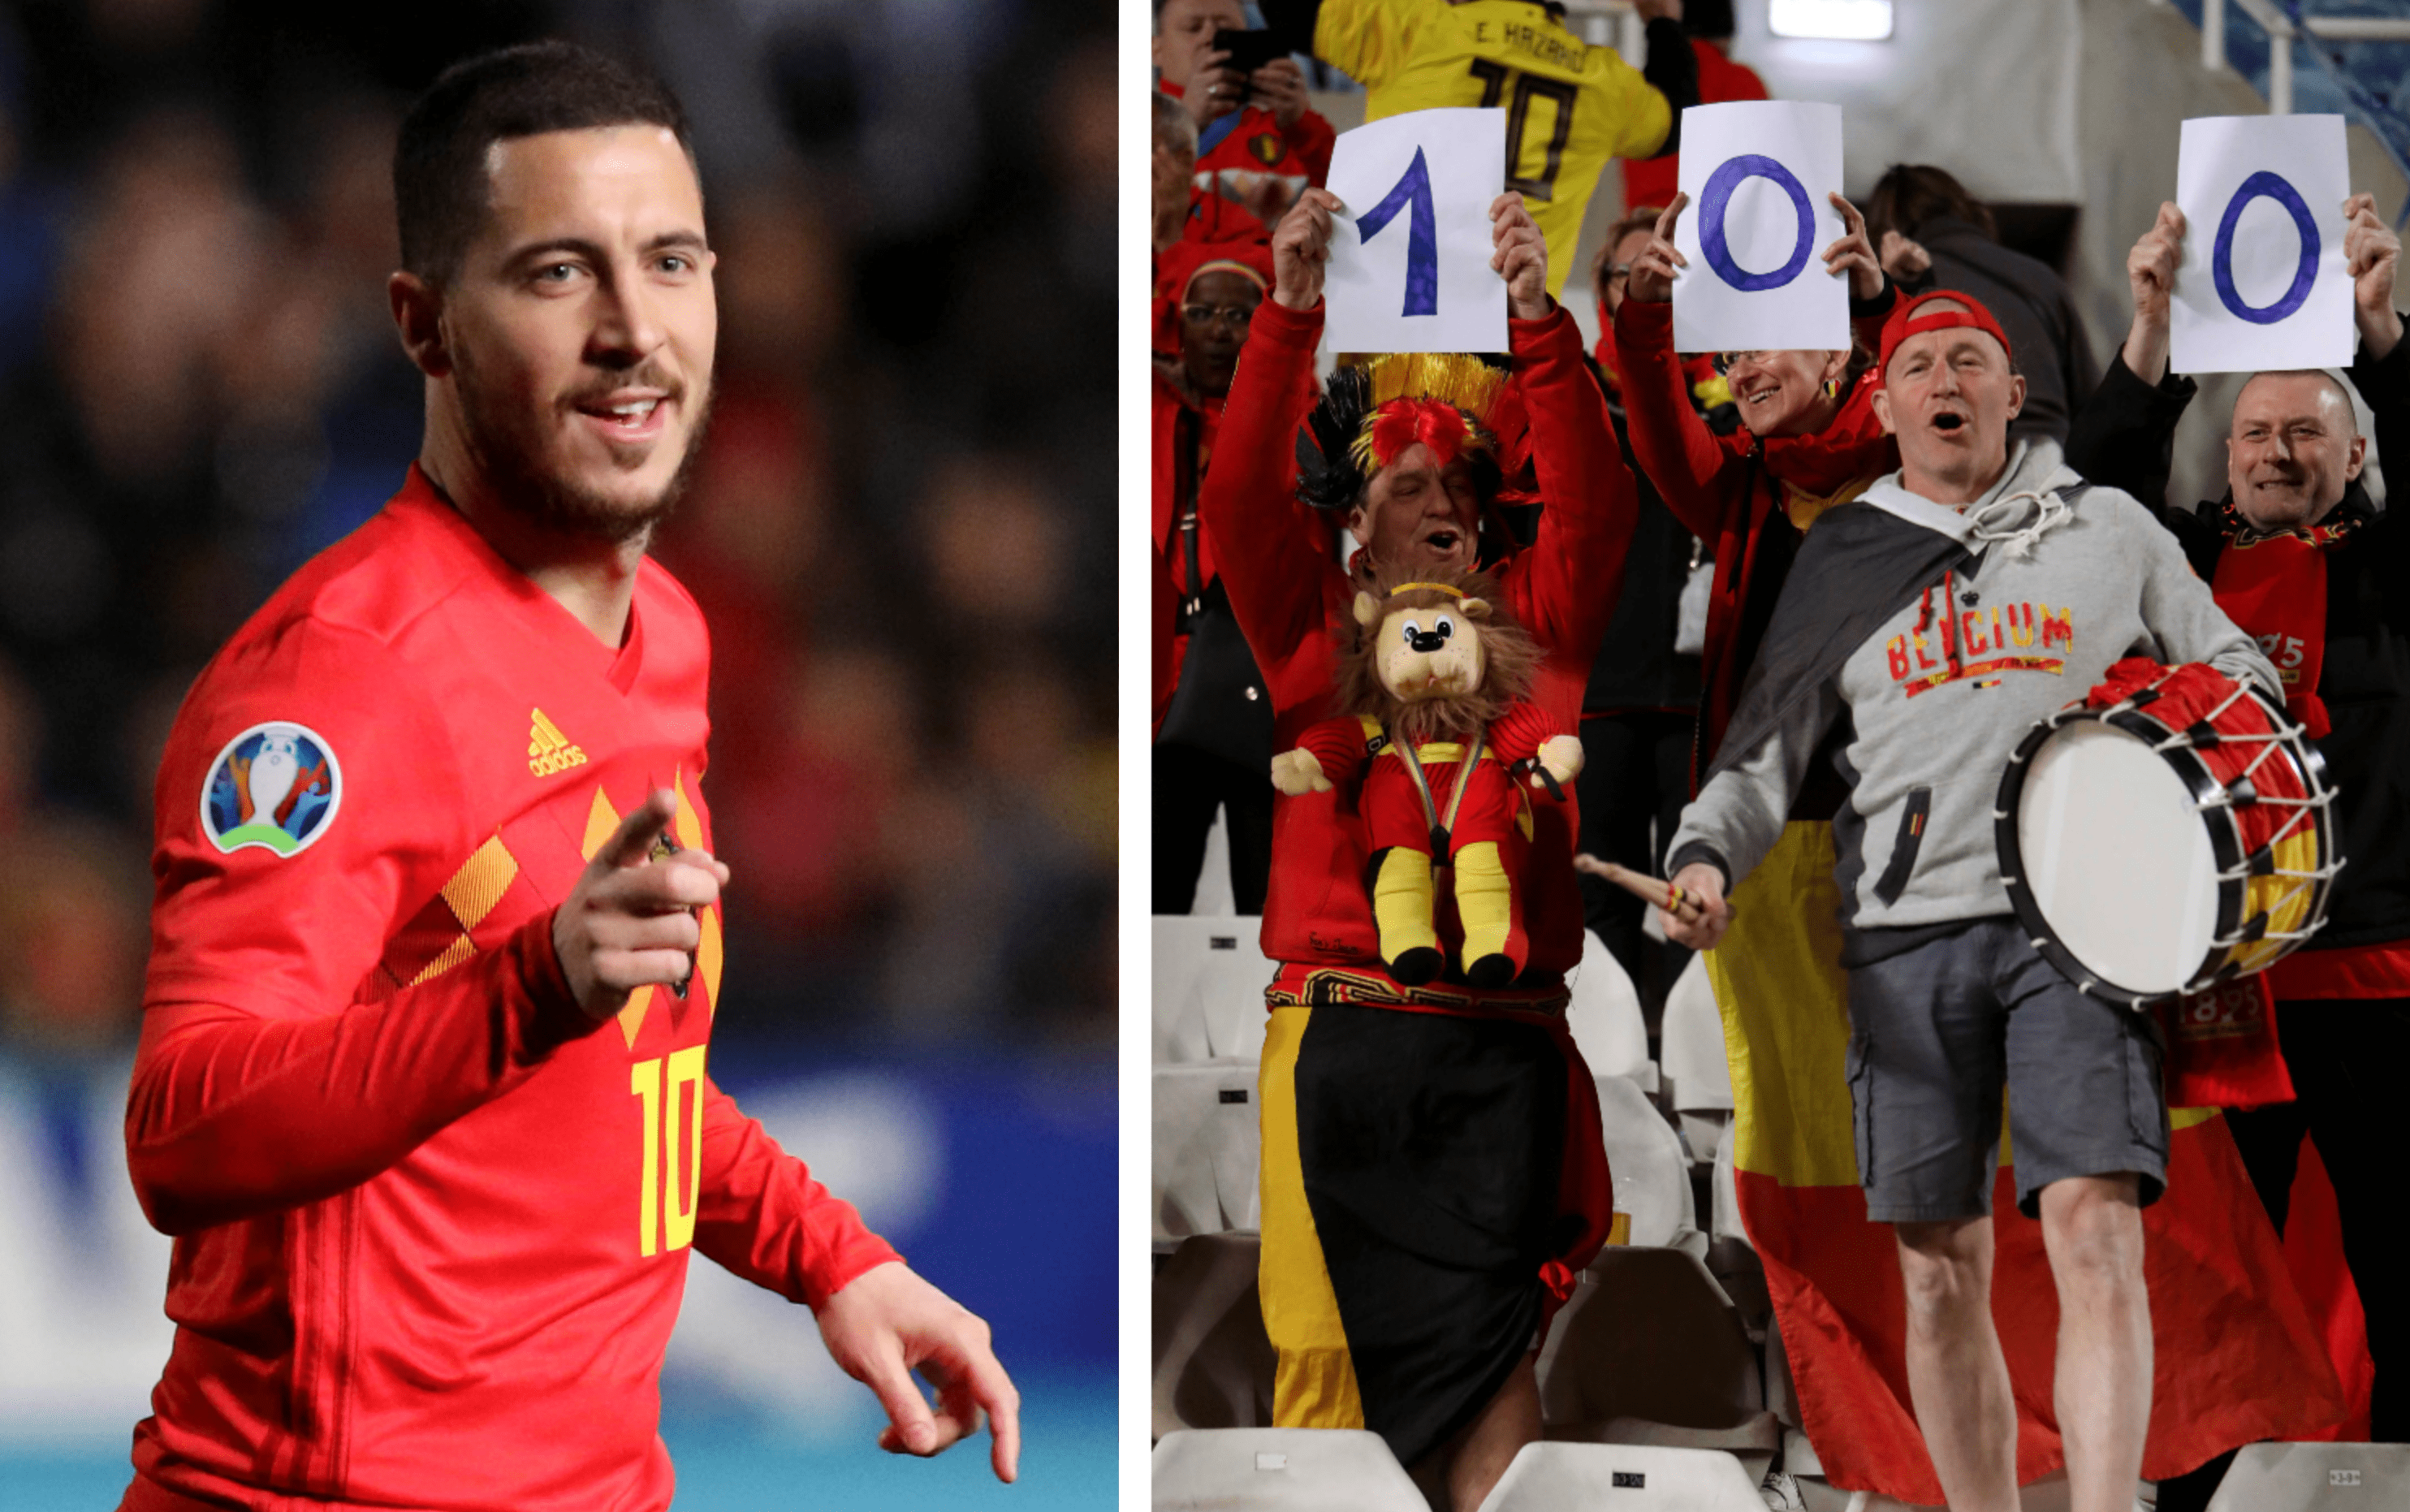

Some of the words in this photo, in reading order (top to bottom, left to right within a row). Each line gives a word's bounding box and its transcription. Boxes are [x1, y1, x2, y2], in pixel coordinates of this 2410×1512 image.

[1355, 145, 1438, 317] 1
[1698, 153, 1816, 292] 0
[2213, 170, 2321, 326] 0
[1886, 602, 2073, 681] BELGIUM
[529, 745, 587, 777] adidas
[631, 1043, 706, 1257] 10
